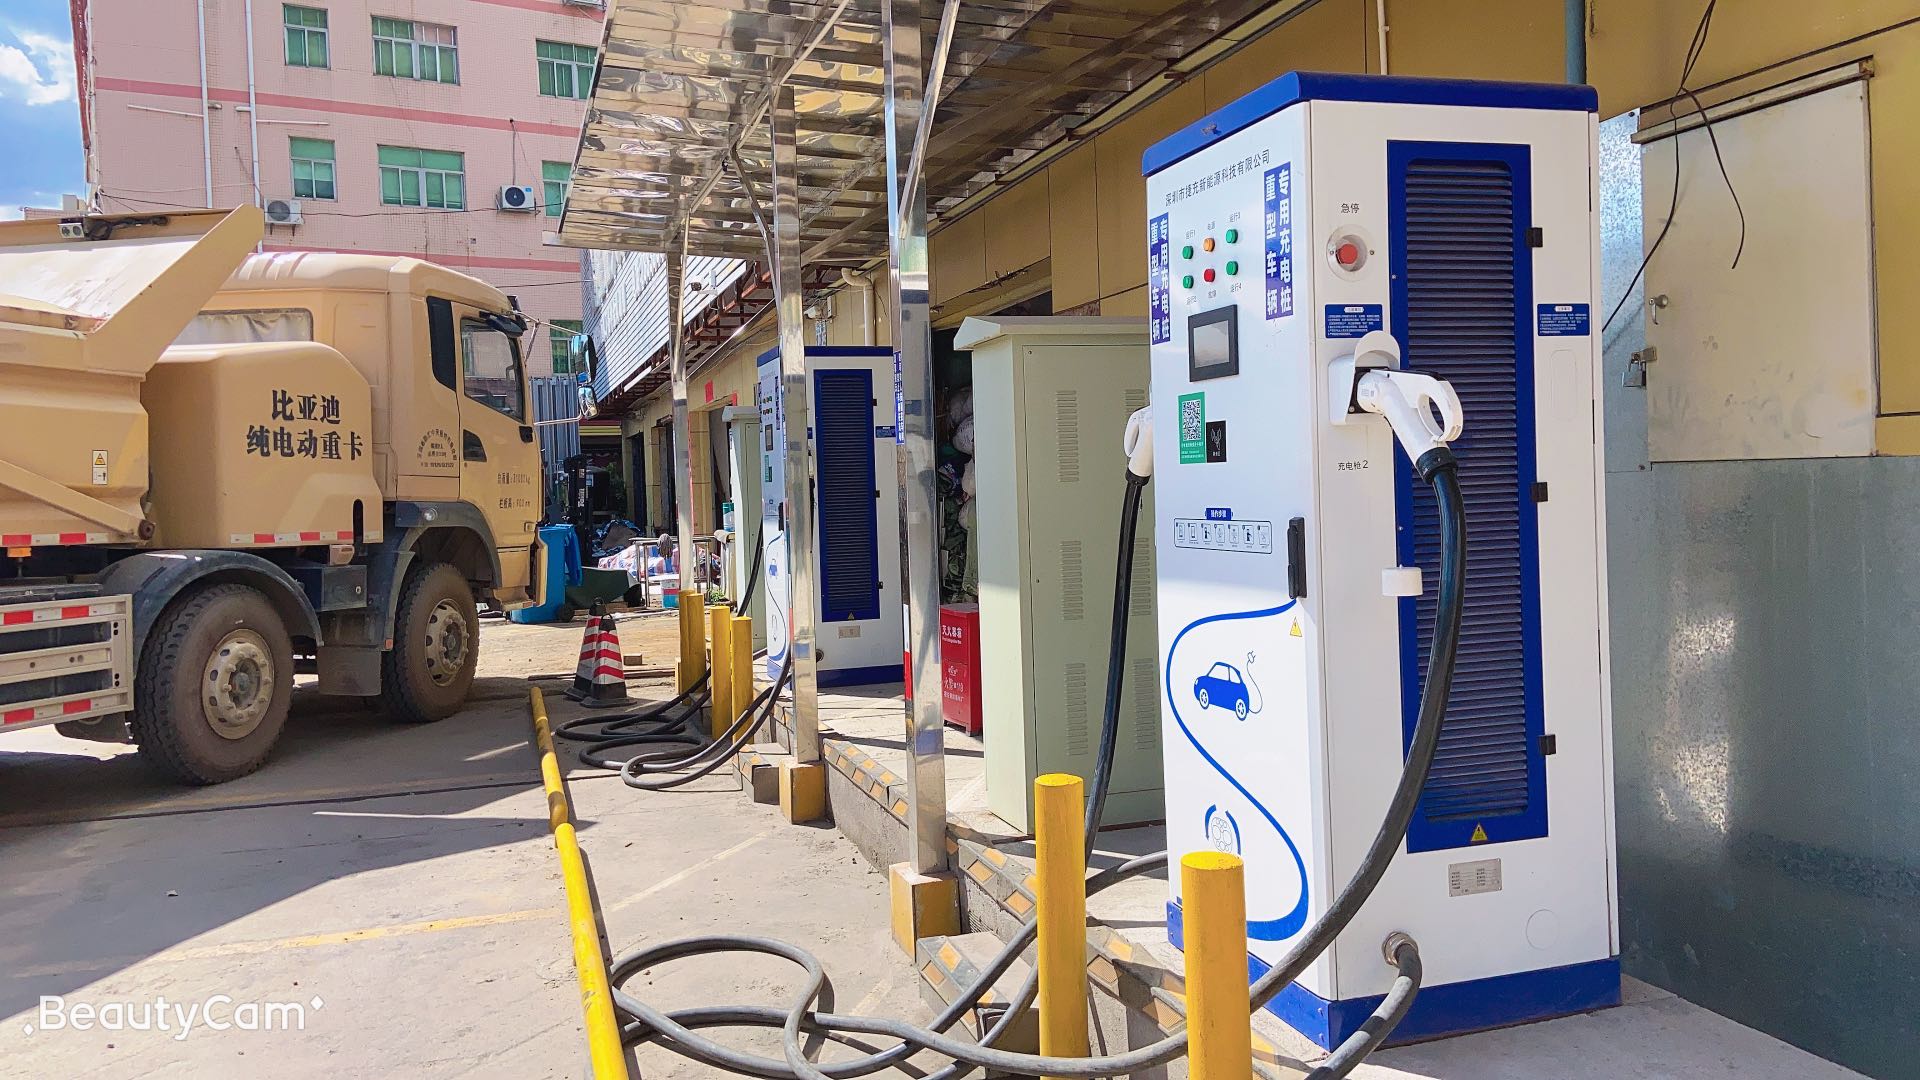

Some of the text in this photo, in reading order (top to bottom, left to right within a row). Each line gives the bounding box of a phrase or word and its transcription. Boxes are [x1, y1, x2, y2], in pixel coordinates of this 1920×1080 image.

[1165, 149, 1270, 207] 深圳市捷充新能源科技有限公司
[1340, 203, 1360, 214] 急停
[1265, 174, 1278, 316] 重型车辆
[1278, 168, 1292, 314] 专用充电桩
[271, 389, 341, 425] 比亚迪
[246, 425, 364, 461] 纯电动重卡
[1337, 459, 1369, 471] 充电枪2
